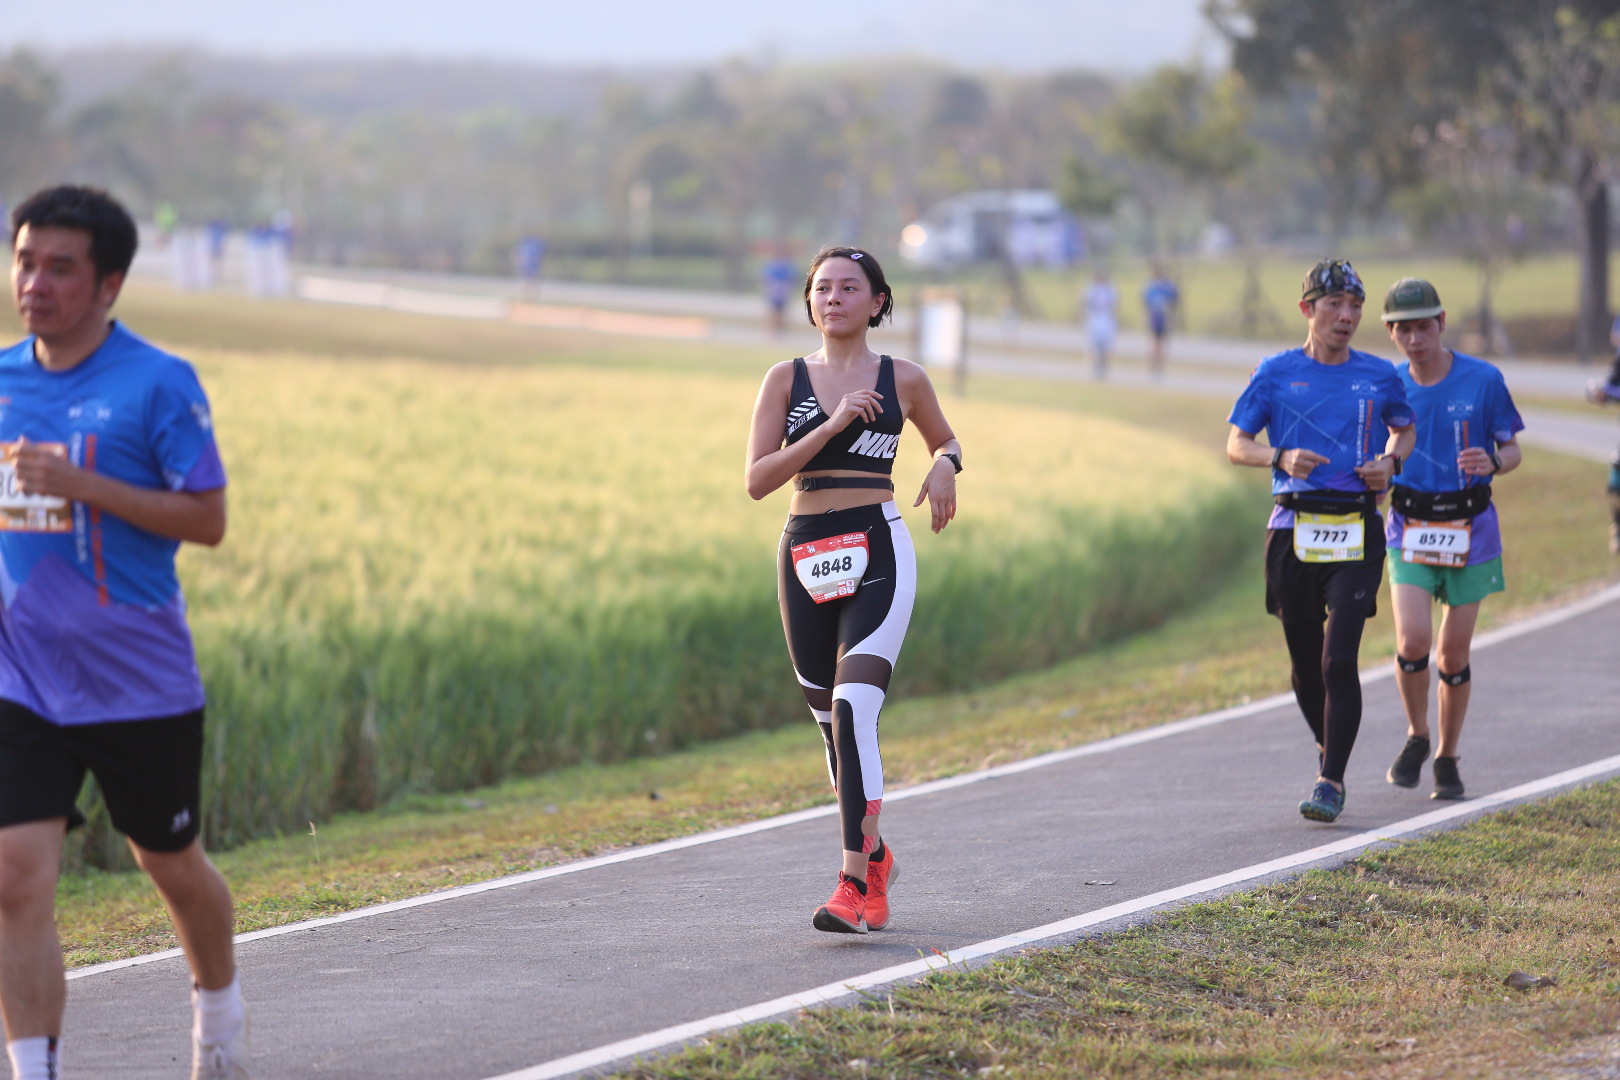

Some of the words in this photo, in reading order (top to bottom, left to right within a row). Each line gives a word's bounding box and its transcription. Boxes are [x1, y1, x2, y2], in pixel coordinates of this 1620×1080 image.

[1312, 529, 1348, 543] 7777
[1419, 533, 1456, 547] 8577
[811, 555, 853, 578] 4848
